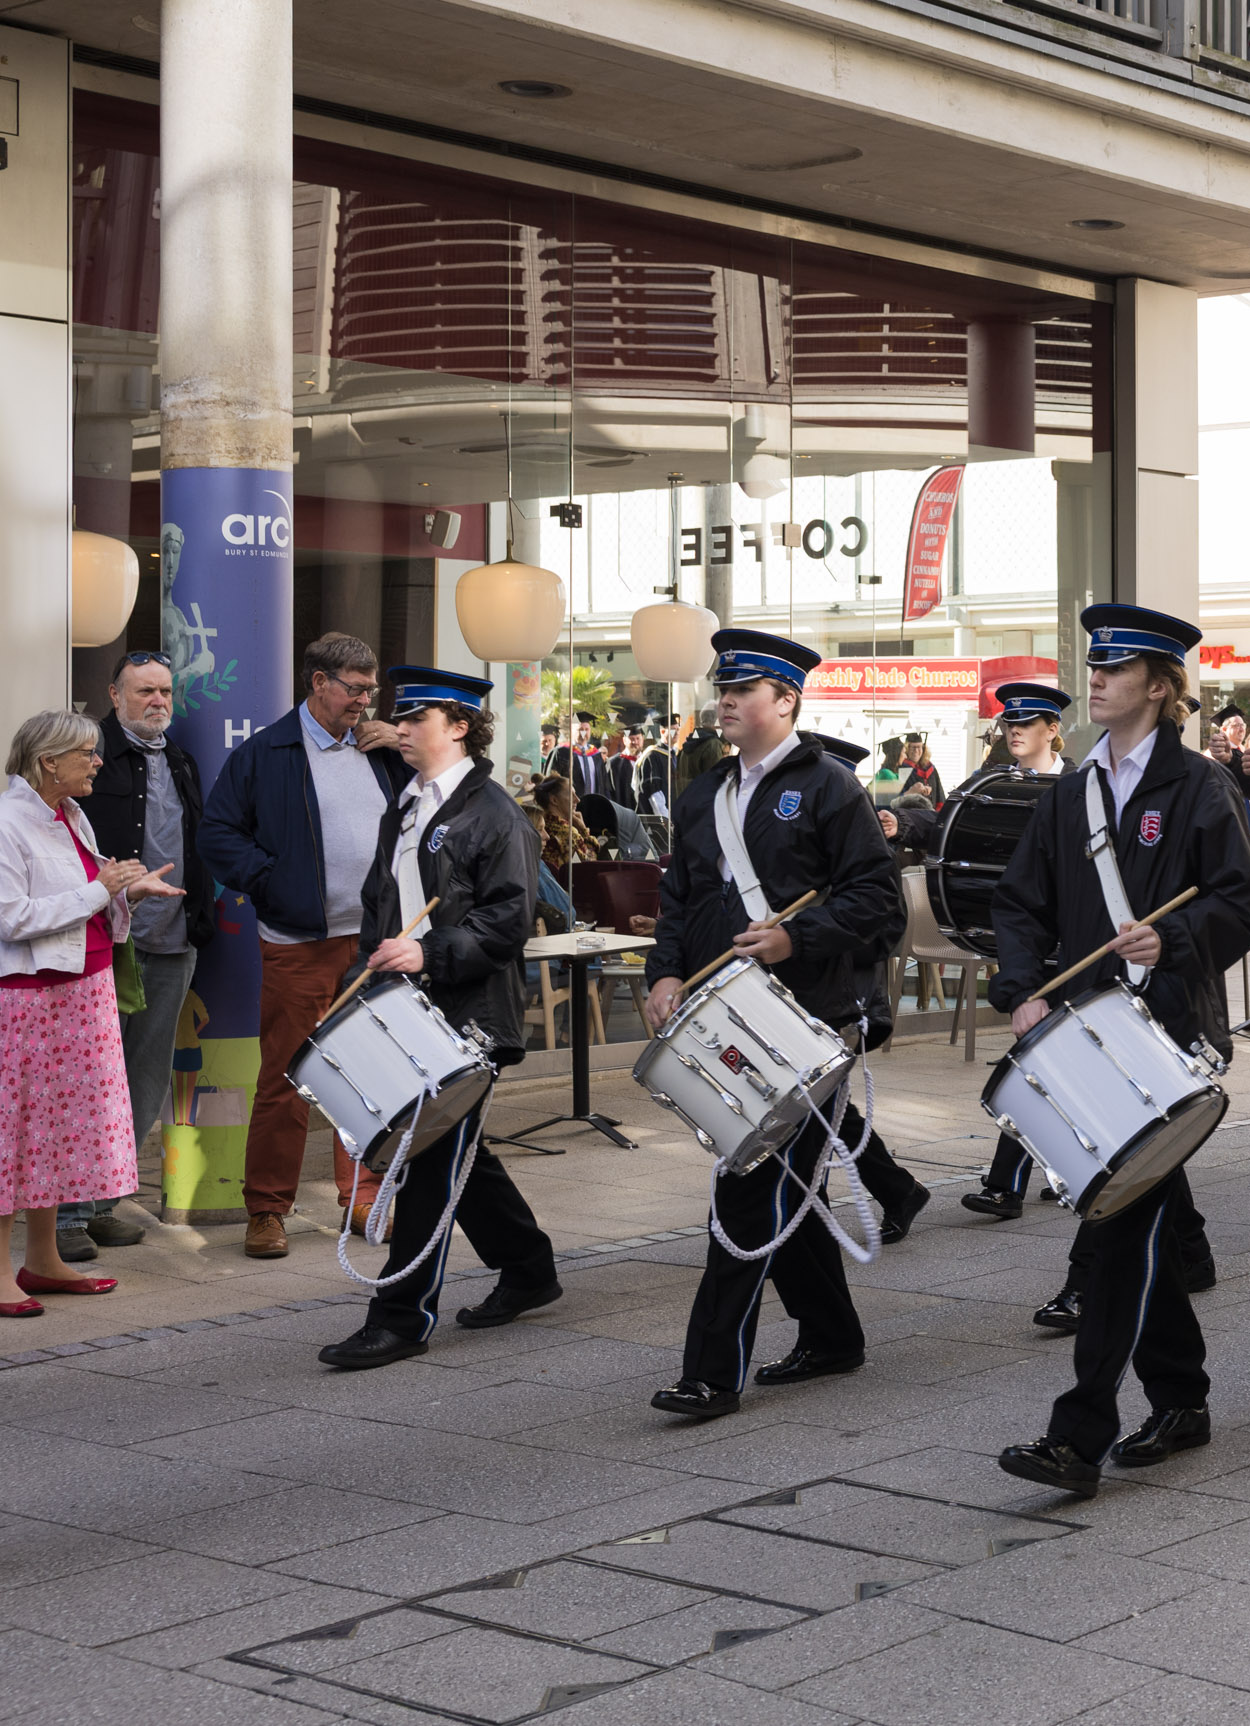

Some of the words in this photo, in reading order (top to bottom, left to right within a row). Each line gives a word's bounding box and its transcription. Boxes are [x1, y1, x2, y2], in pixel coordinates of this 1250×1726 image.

[924, 491, 954, 503] CHURROS
[221, 513, 290, 548] arc
[920, 522, 946, 536] DONUTS
[920, 550, 939, 561] SUGAR
[914, 578, 936, 589] NUTELLA
[1199, 645, 1234, 669] oys
[864, 667, 907, 688] Made
[908, 666, 978, 688] Churros
